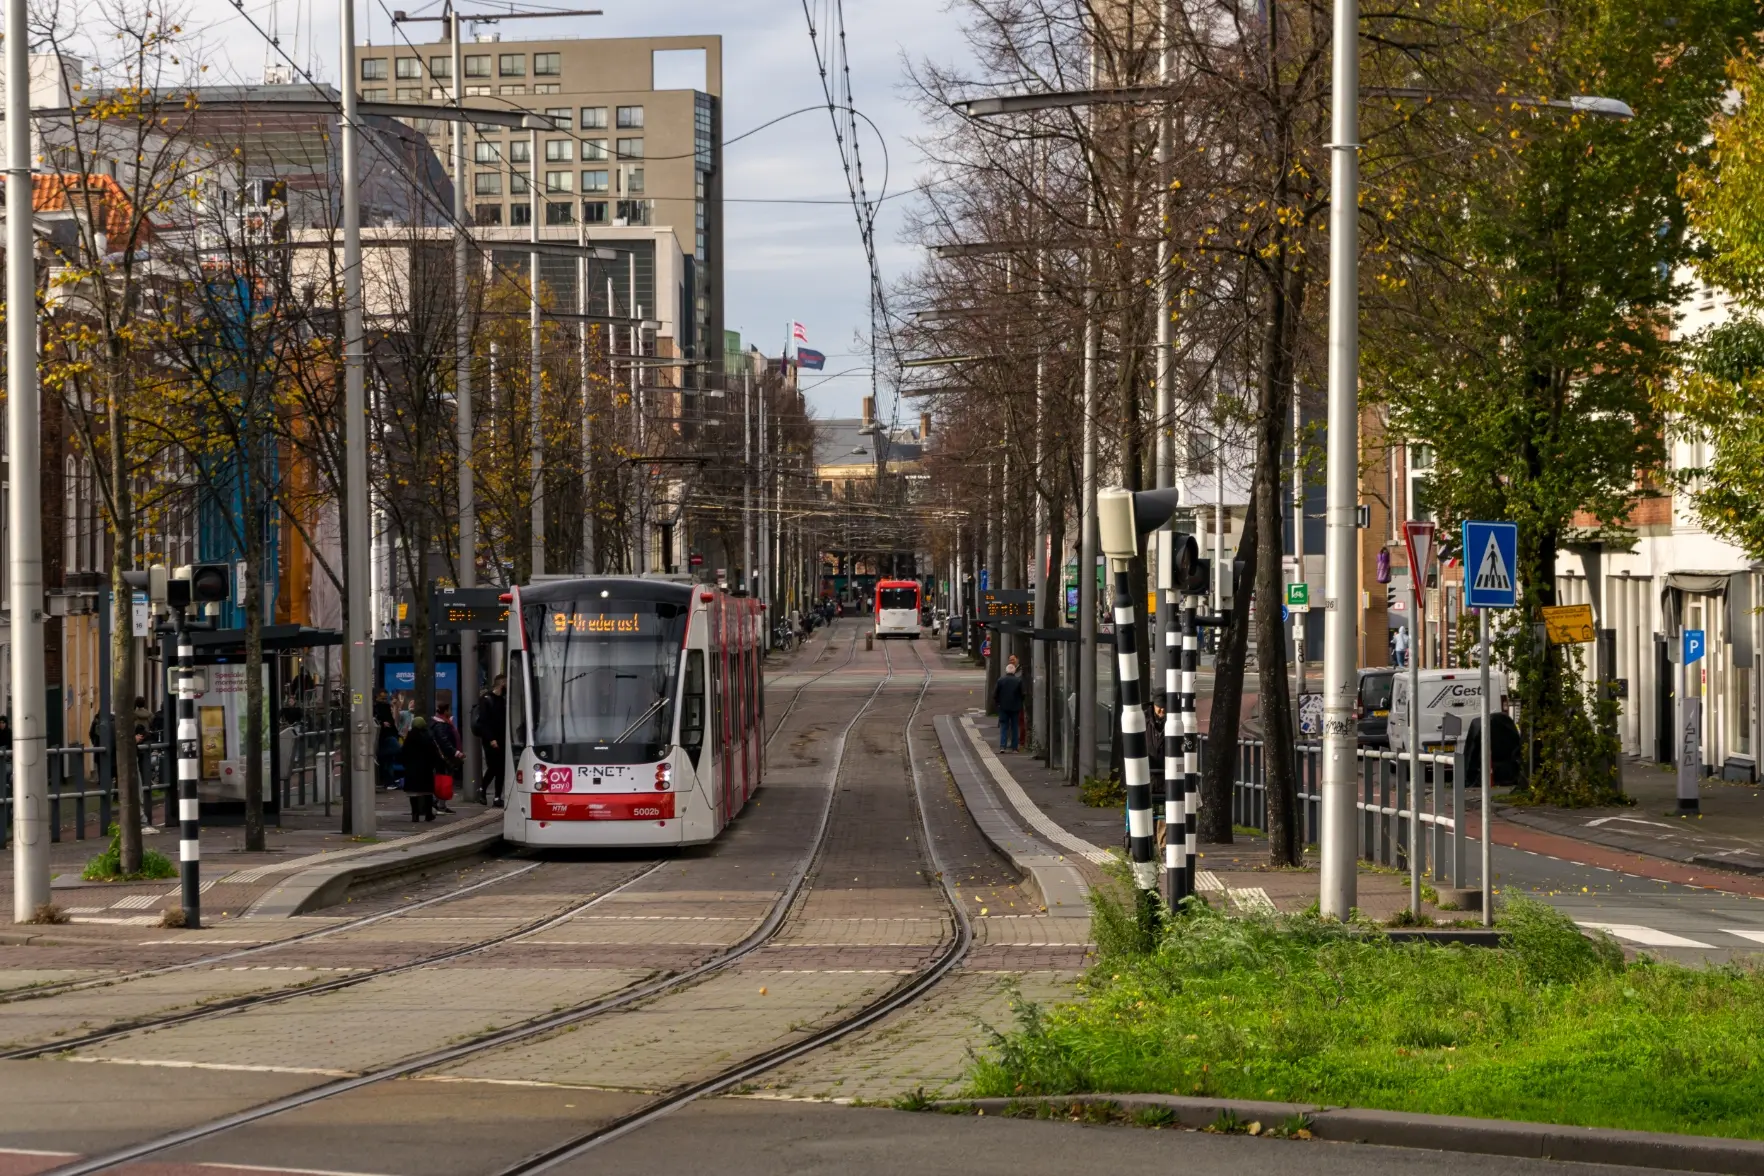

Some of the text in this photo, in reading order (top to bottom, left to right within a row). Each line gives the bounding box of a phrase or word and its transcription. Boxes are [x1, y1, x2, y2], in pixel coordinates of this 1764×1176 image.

[1689, 639, 1699, 654] P
[550, 771, 570, 783] OV
[550, 782, 565, 790] pay
[633, 807, 660, 816] 5002b
